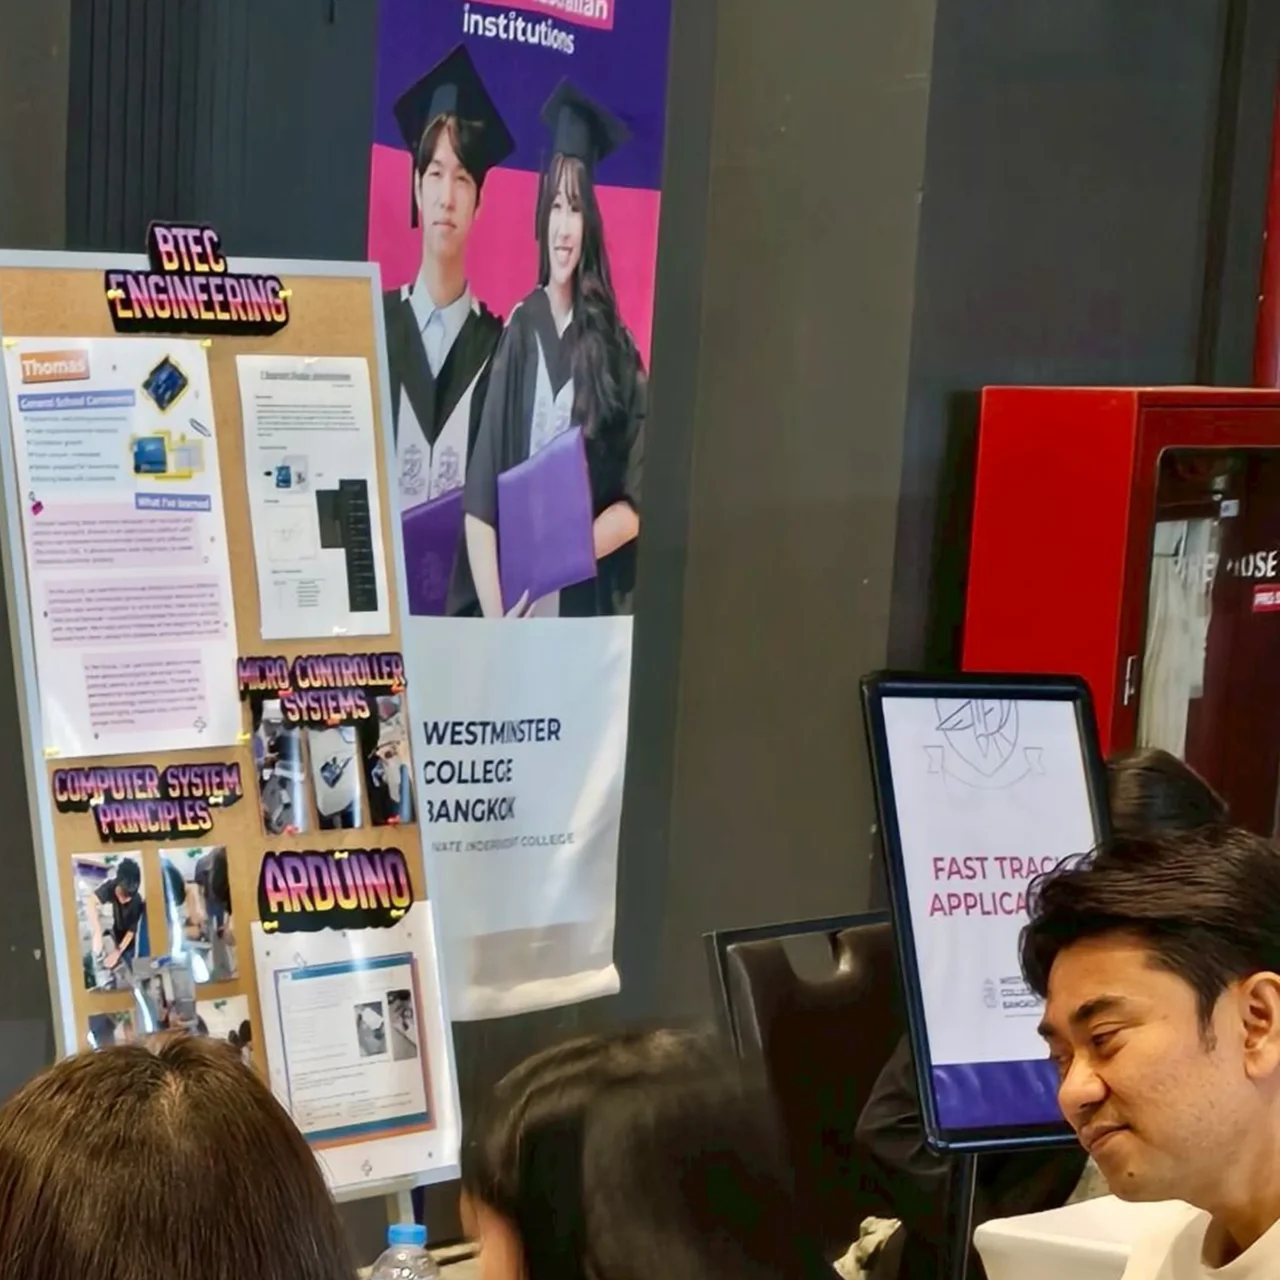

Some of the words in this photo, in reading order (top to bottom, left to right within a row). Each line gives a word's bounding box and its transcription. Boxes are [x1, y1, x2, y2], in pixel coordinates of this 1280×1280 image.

[463, 3, 575, 54] institutions
[153, 226, 225, 273] BTEC
[108, 273, 287, 323] ENGINEERING
[237, 657, 290, 690] MICRO
[296, 655, 406, 689] CONTROLLER
[283, 690, 371, 722] SYSTEMS
[423, 718, 562, 745] WESTMINSTER
[54, 767, 161, 801] COMPUTER
[166, 764, 242, 798] SYSTEM
[423, 758, 514, 785] COLLEGE
[98, 803, 213, 834] PRINCIPLES
[264, 851, 410, 911] ARDUINO
[932, 856, 989, 881] FAST
[993, 855, 1059, 880] TRAC
[929, 891, 1029, 917] APPLICA
